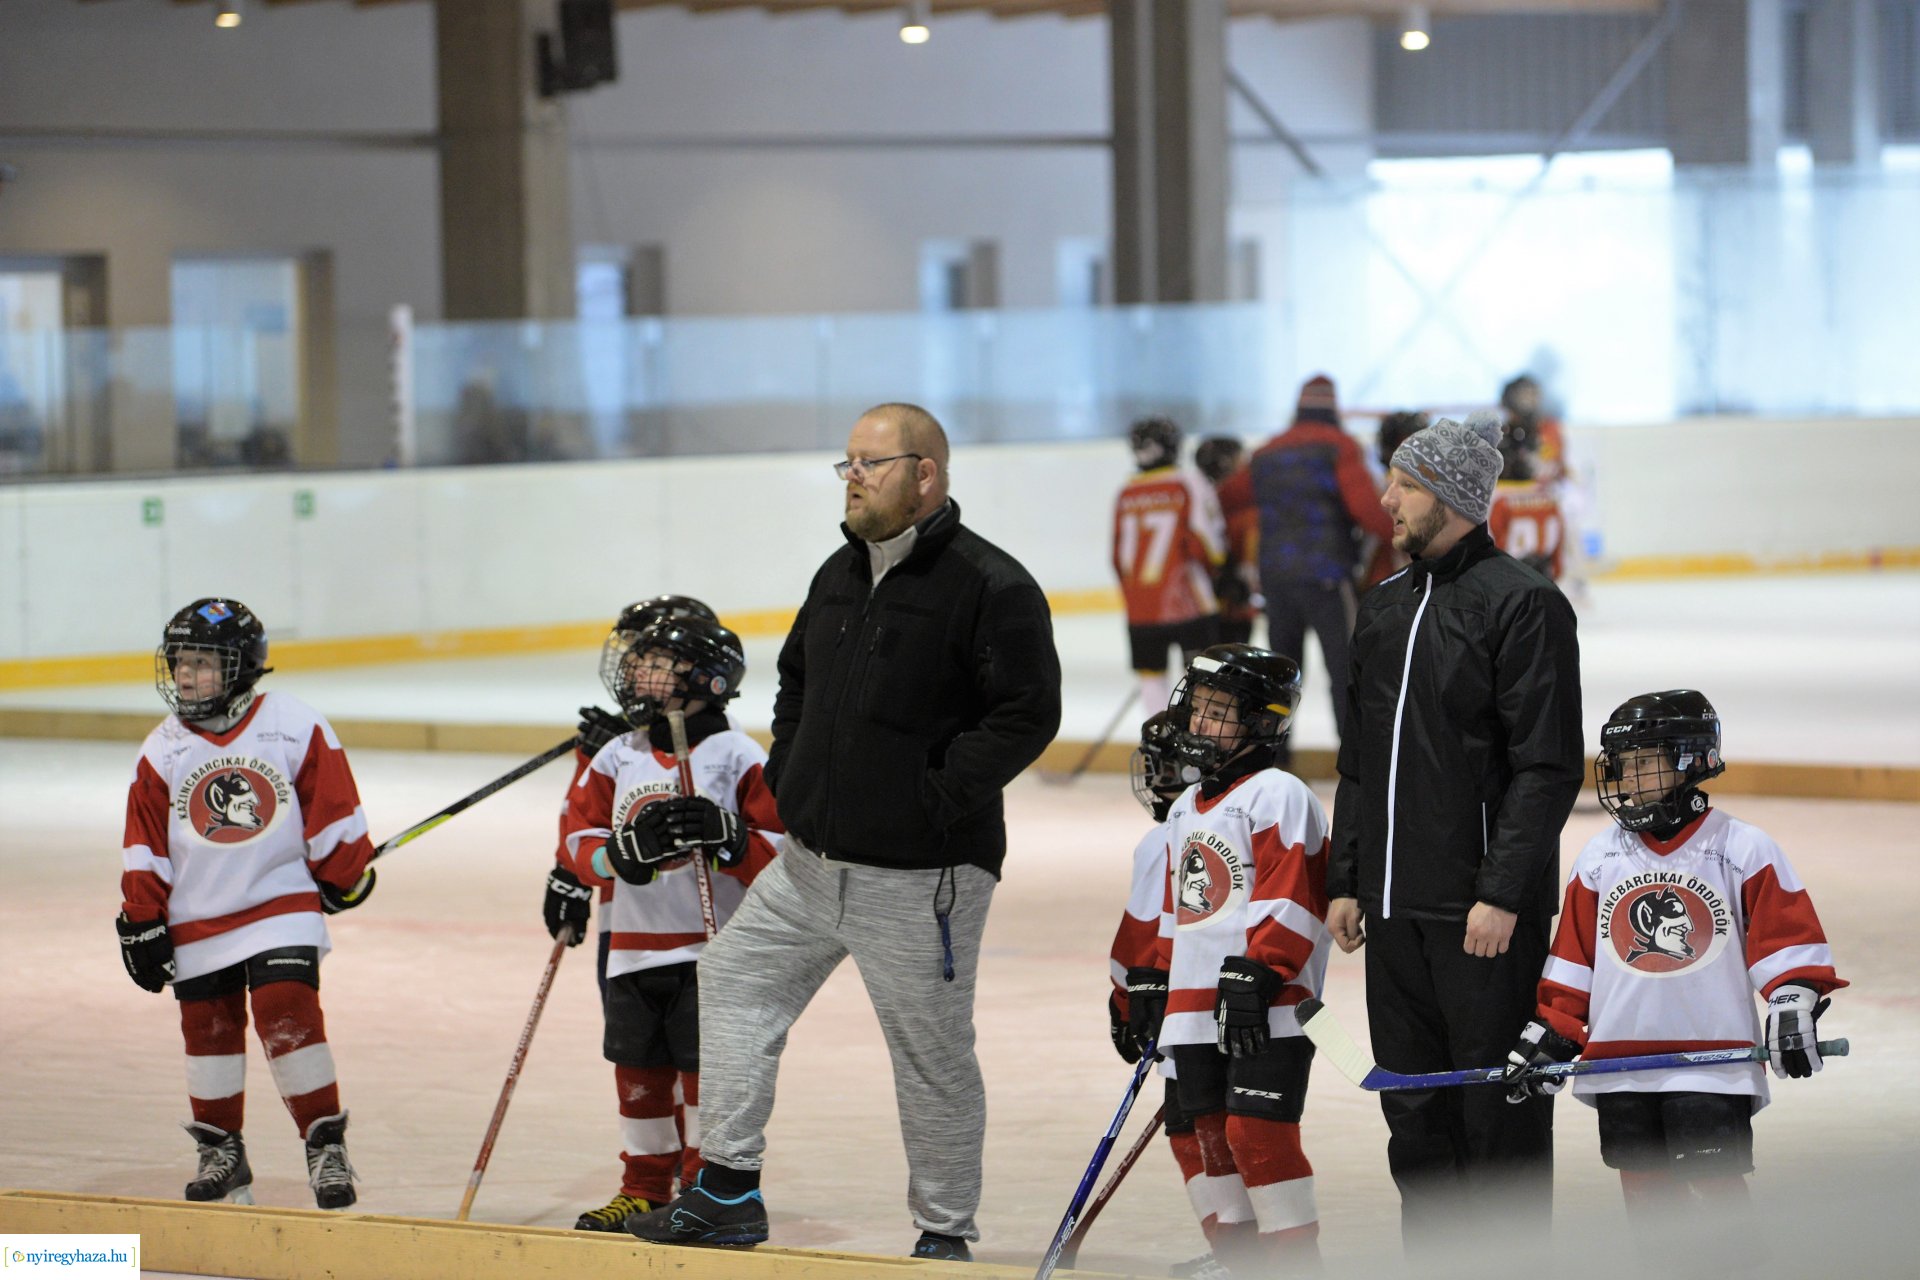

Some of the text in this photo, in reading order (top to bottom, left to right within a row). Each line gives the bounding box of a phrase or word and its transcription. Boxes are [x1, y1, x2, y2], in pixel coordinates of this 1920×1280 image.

[1119, 511, 1178, 584] 17
[1605, 725, 1632, 735] CCM
[1600, 872, 1731, 938] KAZINCBARCIKAI ÖRDÖGÖK
[1232, 1086, 1283, 1100] TPS
